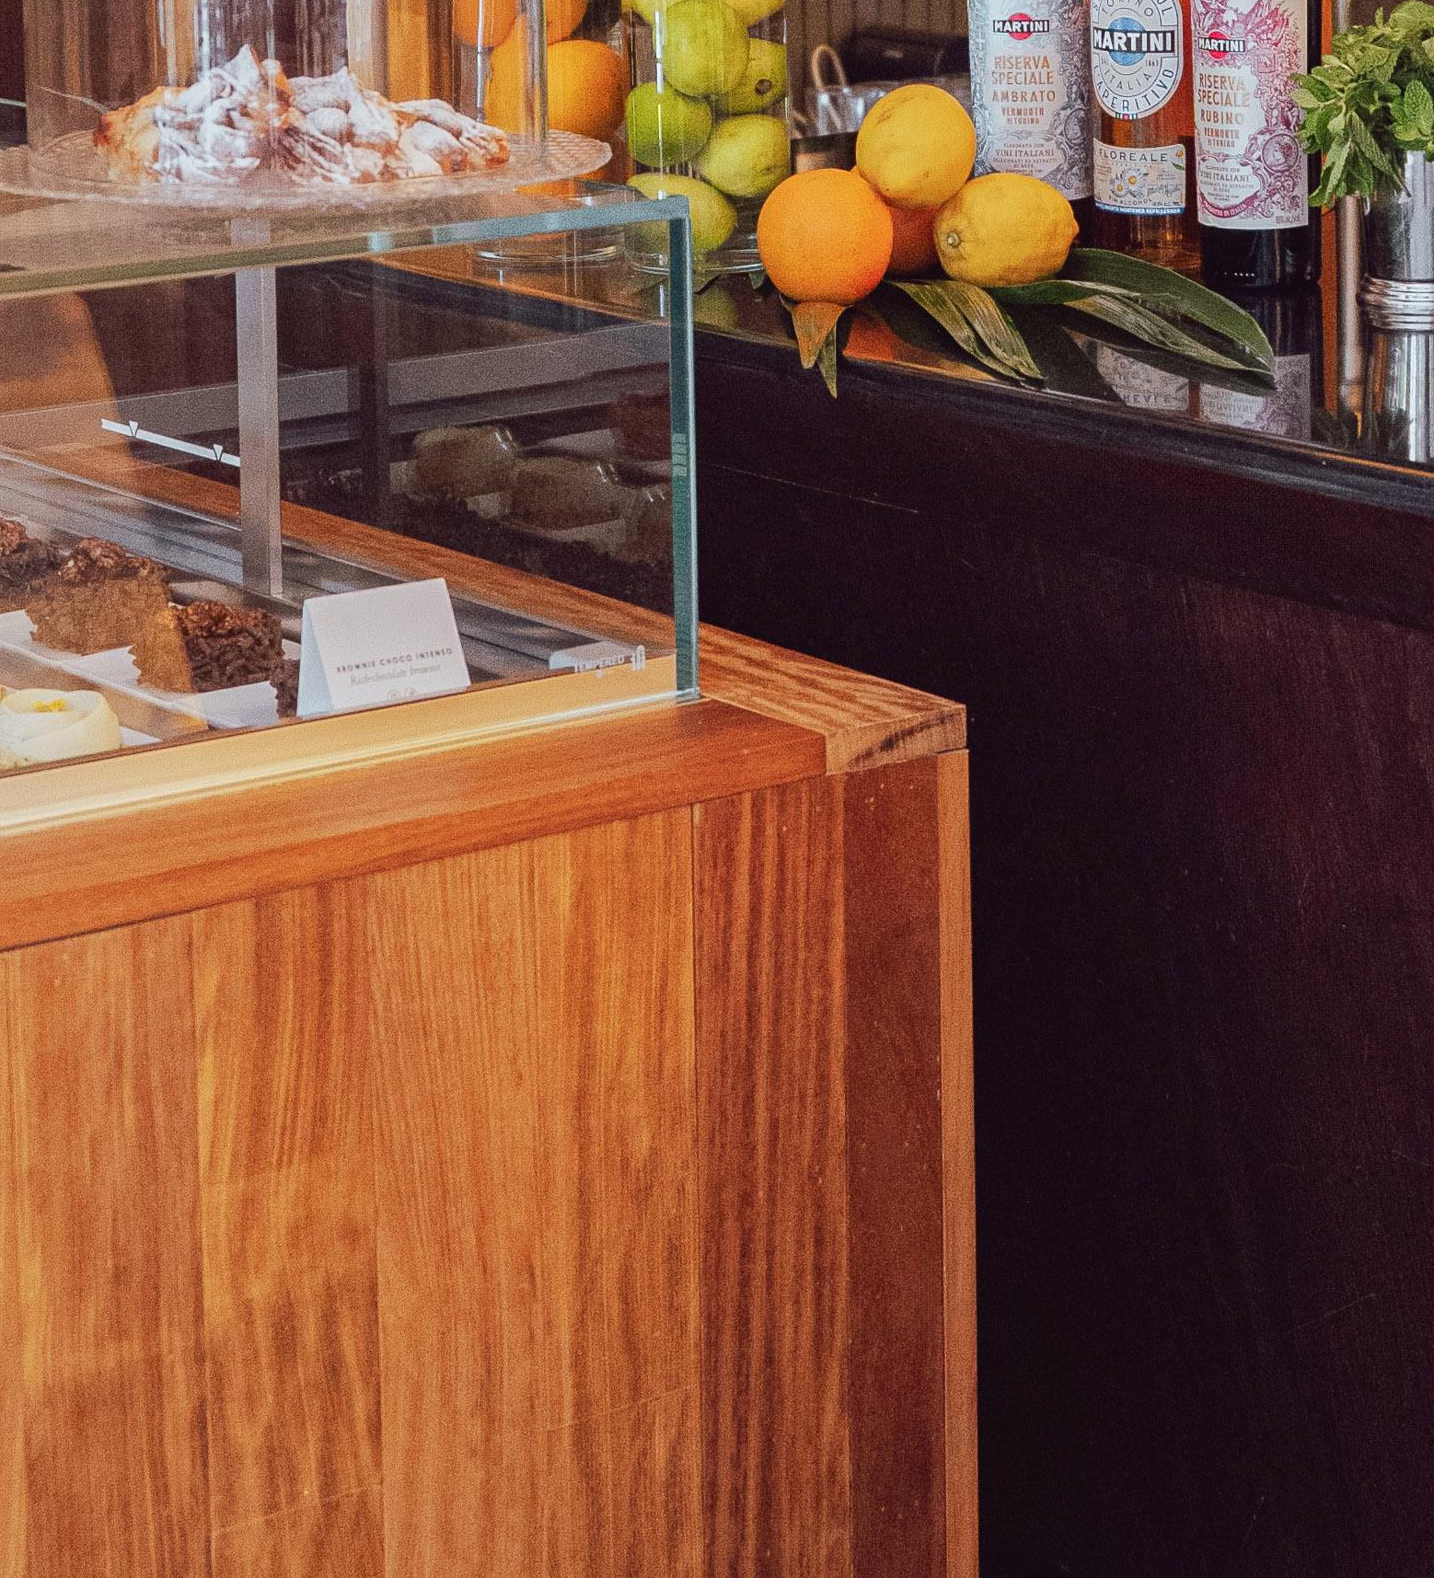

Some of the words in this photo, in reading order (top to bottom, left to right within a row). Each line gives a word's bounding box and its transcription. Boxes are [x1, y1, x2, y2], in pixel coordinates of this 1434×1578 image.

[994, 20, 1049, 32] MARTINI
[1093, 29, 1172, 52] MARTINI
[1198, 38, 1245, 52] MARTINI
[994, 56, 1050, 70] RISERVA
[992, 71, 1055, 85] SPECIALE
[1104, 70, 1152, 91] ITALIA
[1199, 73, 1246, 91] RISERVA
[992, 90, 1056, 103] AMBRATO
[1198, 89, 1251, 108] SPECIALE
[1001, 107, 1045, 116] VERMOUTH
[1200, 109, 1245, 125] RUBINO
[1204, 127, 1240, 139] VERMOUTH
[995, 149, 1013, 157] VINI
[1014, 149, 1055, 157] ITALIANI
[1099, 148, 1168, 162] FLOREALE
[1213, 172, 1250, 182] ITALIANI
[336, 661, 376, 674] BROWNIE
[379, 654, 413, 667] CHOCO
[415, 647, 453, 660] INTENSO
